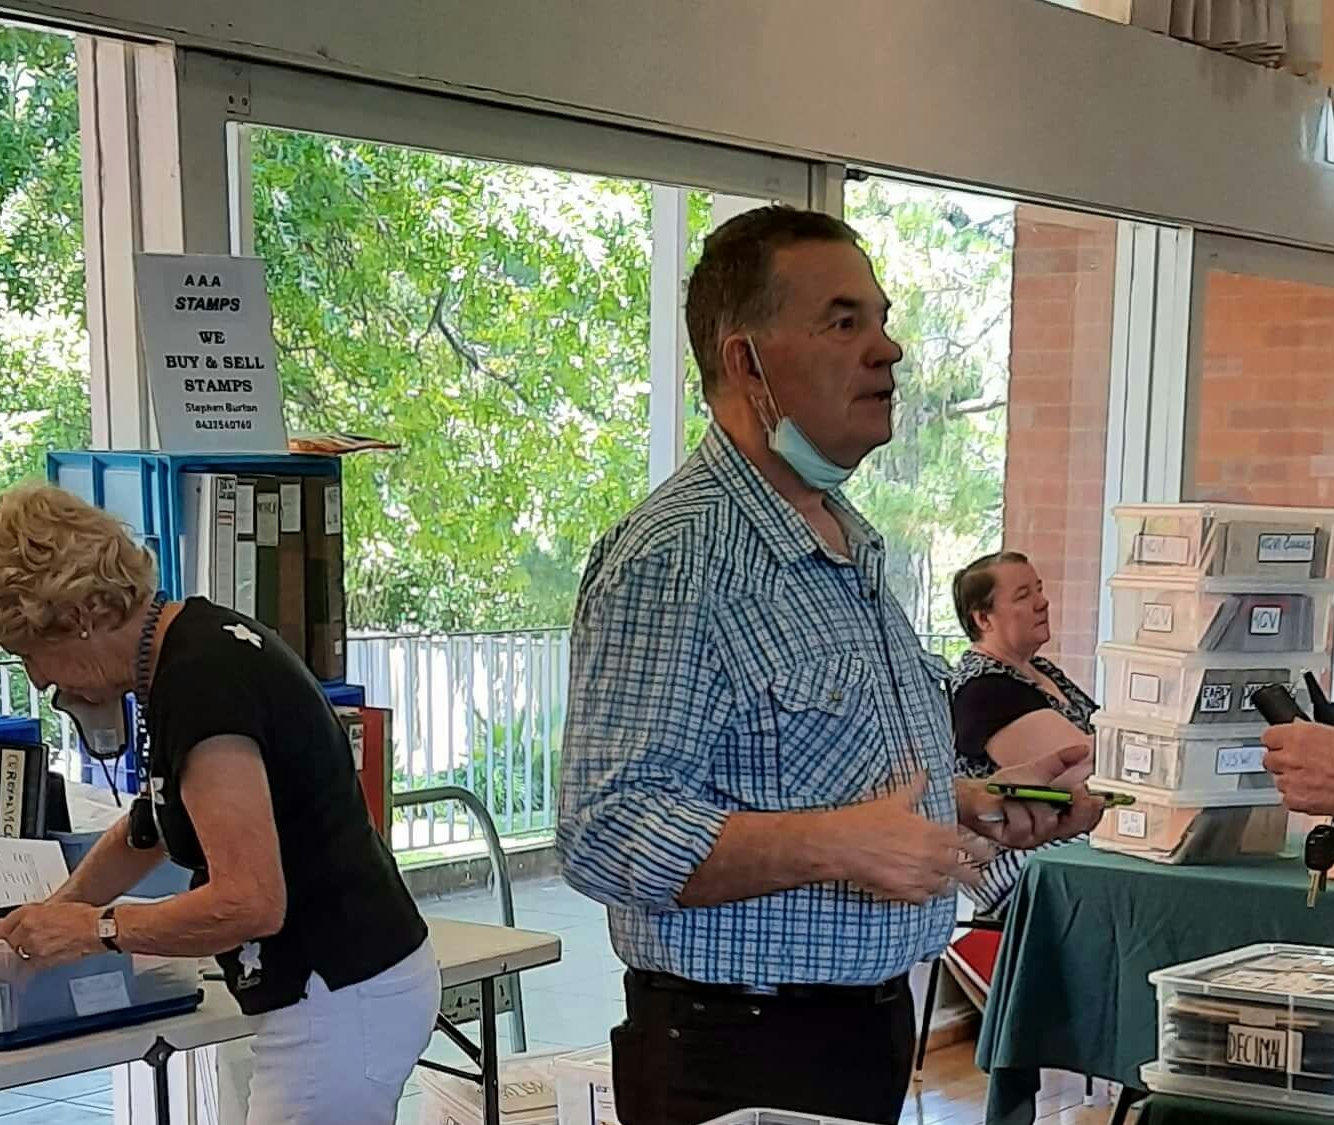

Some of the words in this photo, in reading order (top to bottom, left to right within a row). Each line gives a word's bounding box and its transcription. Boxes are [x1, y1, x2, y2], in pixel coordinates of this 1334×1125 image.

[175, 297, 240, 311] STAMPS
[199, 331, 225, 344] WE
[165, 356, 199, 368] BUY
[206, 357, 217, 368] &
[224, 357, 264, 369] SELL
[185, 379, 253, 392] STAMPS
[185, 402, 224, 414] Stephen
